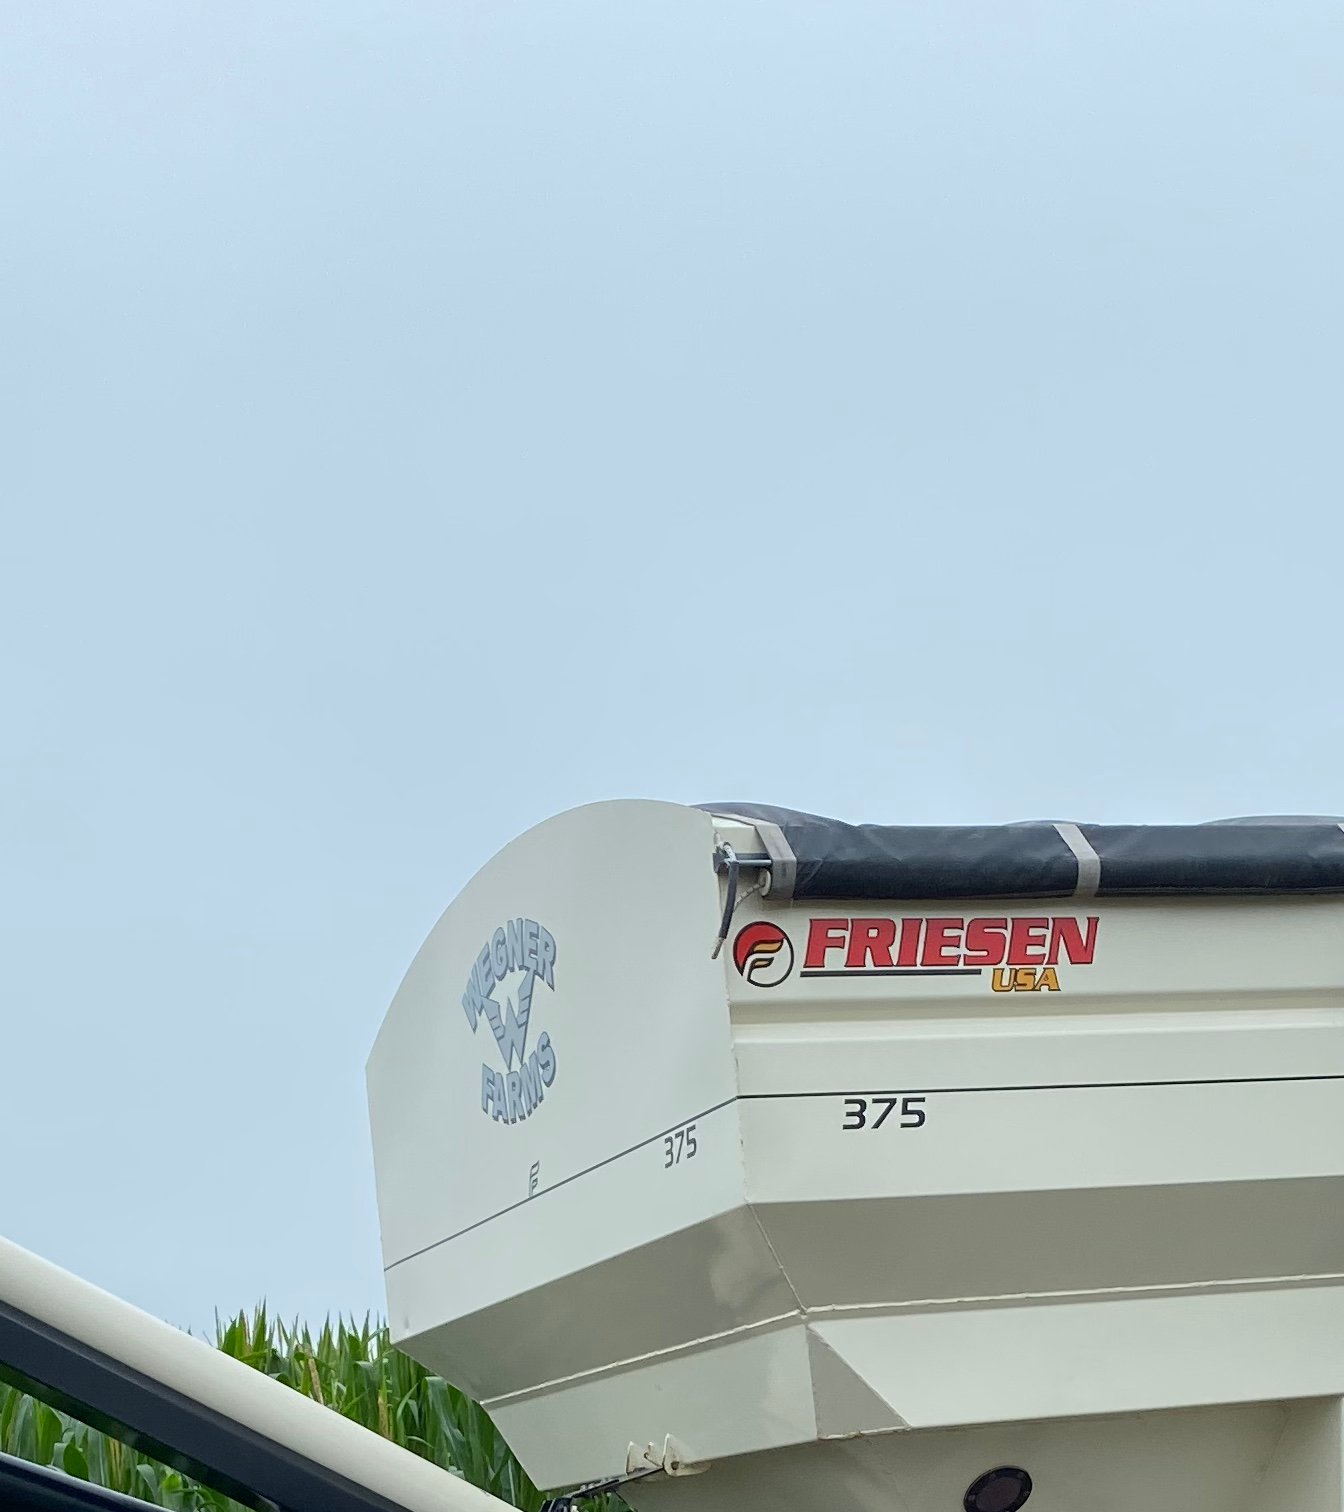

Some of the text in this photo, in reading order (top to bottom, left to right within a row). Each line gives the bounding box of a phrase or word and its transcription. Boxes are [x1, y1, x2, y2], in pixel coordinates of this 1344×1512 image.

[803, 916, 1099, 968] FRIESEN
[462, 918, 556, 1034] WEGNER
[991, 967, 1061, 992] USA
[481, 1031, 556, 1125] FARMS
[842, 1097, 926, 1130] 375
[664, 1125, 697, 1168] 375
